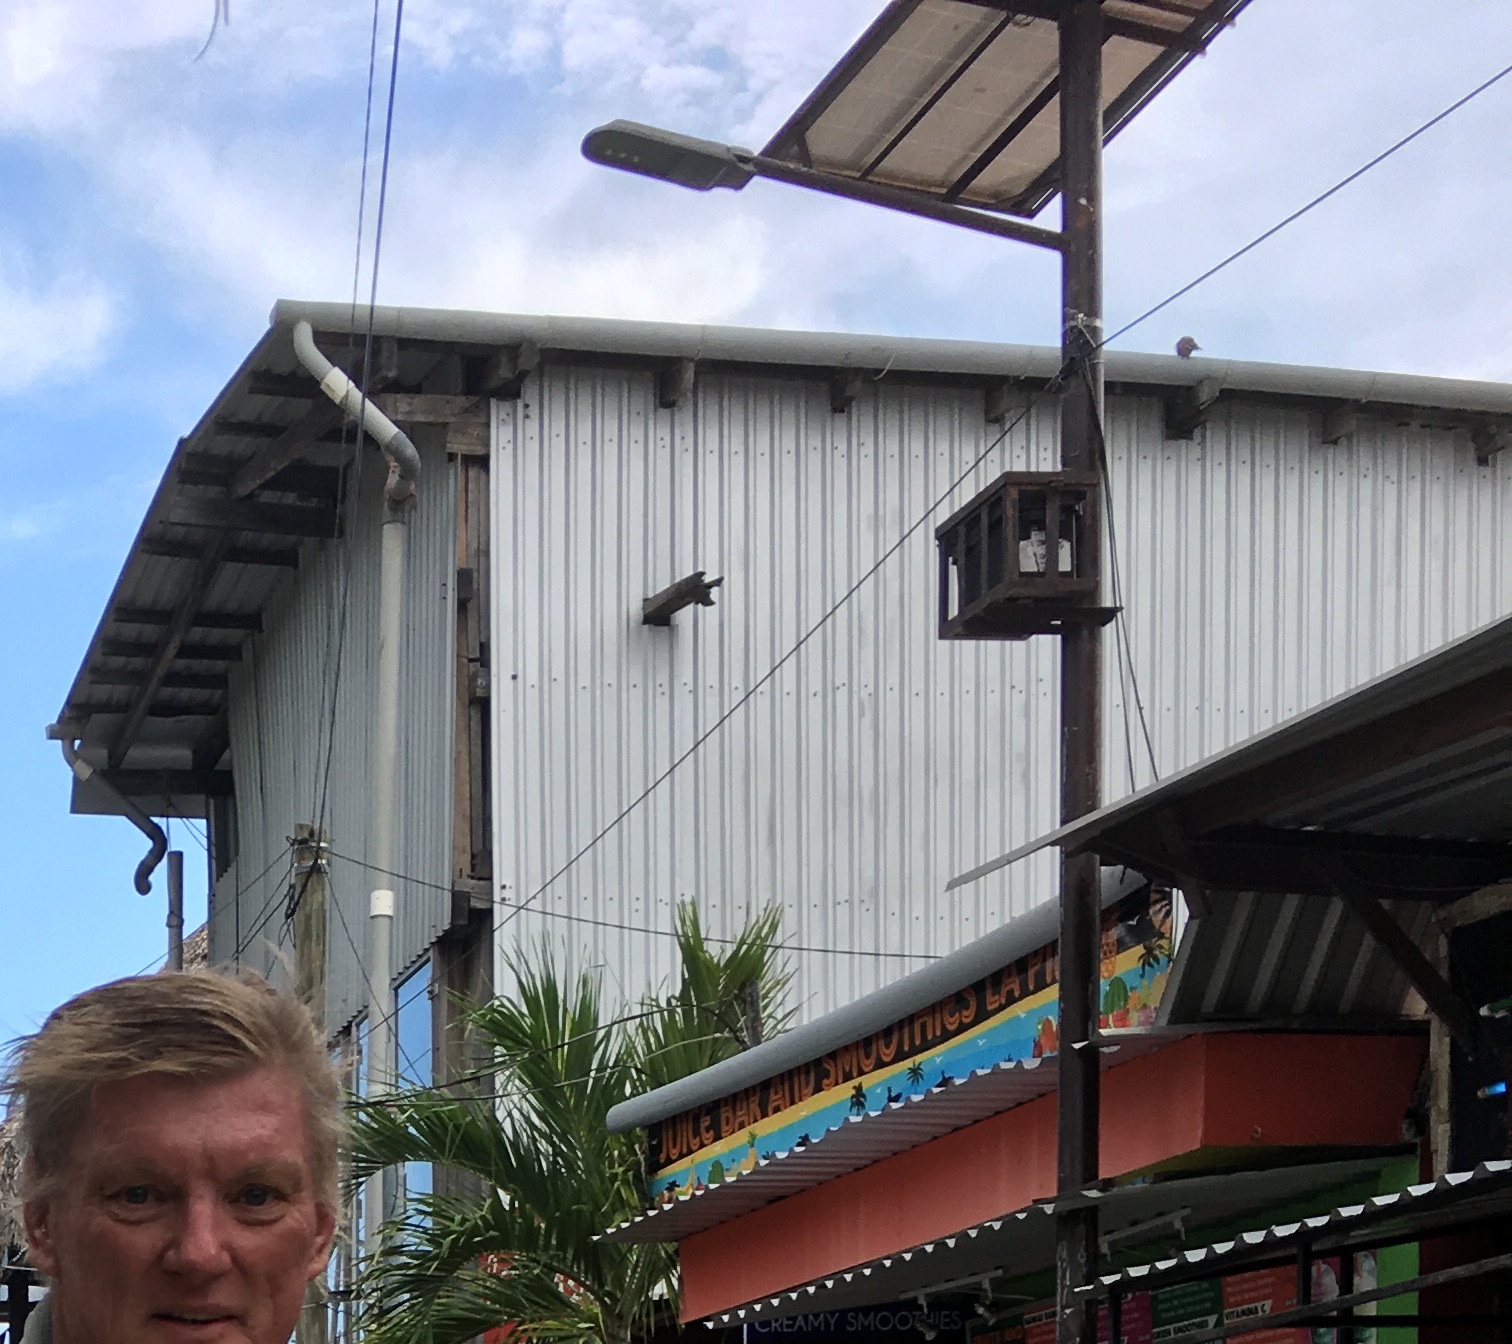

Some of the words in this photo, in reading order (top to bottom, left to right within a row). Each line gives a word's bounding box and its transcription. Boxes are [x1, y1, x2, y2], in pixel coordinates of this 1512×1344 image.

[660, 1111, 715, 1164] JUICE
[720, 1087, 762, 1137] BAR
[767, 1065, 816, 1117] AND
[821, 989, 978, 1091] SMOOTHIES
[985, 964, 1021, 1011] LA
[754, 1312, 839, 1332] CREAMY
[1225, 1304, 1258, 1321] VITAMINA
[1260, 1303, 1267, 1314] C
